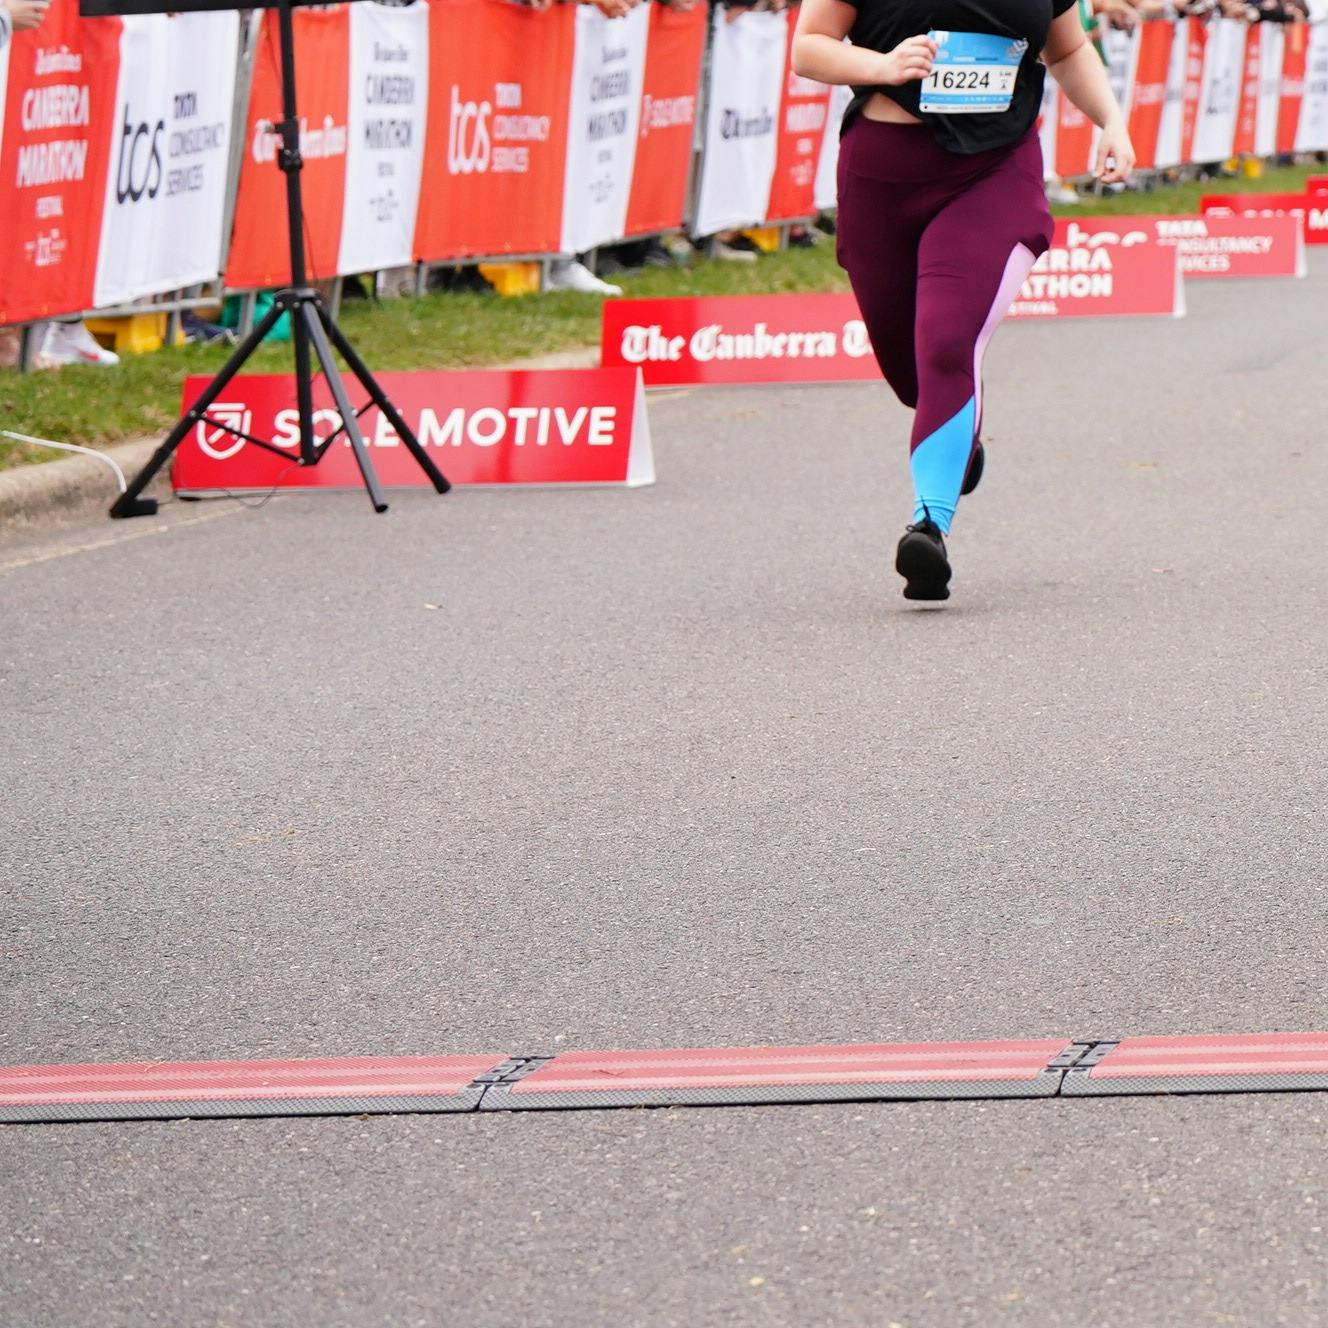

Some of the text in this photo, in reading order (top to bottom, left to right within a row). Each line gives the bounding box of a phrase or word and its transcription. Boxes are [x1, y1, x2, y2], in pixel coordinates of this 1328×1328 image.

[930, 71, 991, 89] 16224
[448, 83, 492, 175] tcs
[117, 102, 165, 205] tcs
[1155, 221, 1209, 239] TATA
[1016, 273, 1113, 299] ATHON
[620, 323, 686, 363] The
[689, 322, 837, 362] Canberra
[418, 406, 617, 447] MOTIVE
